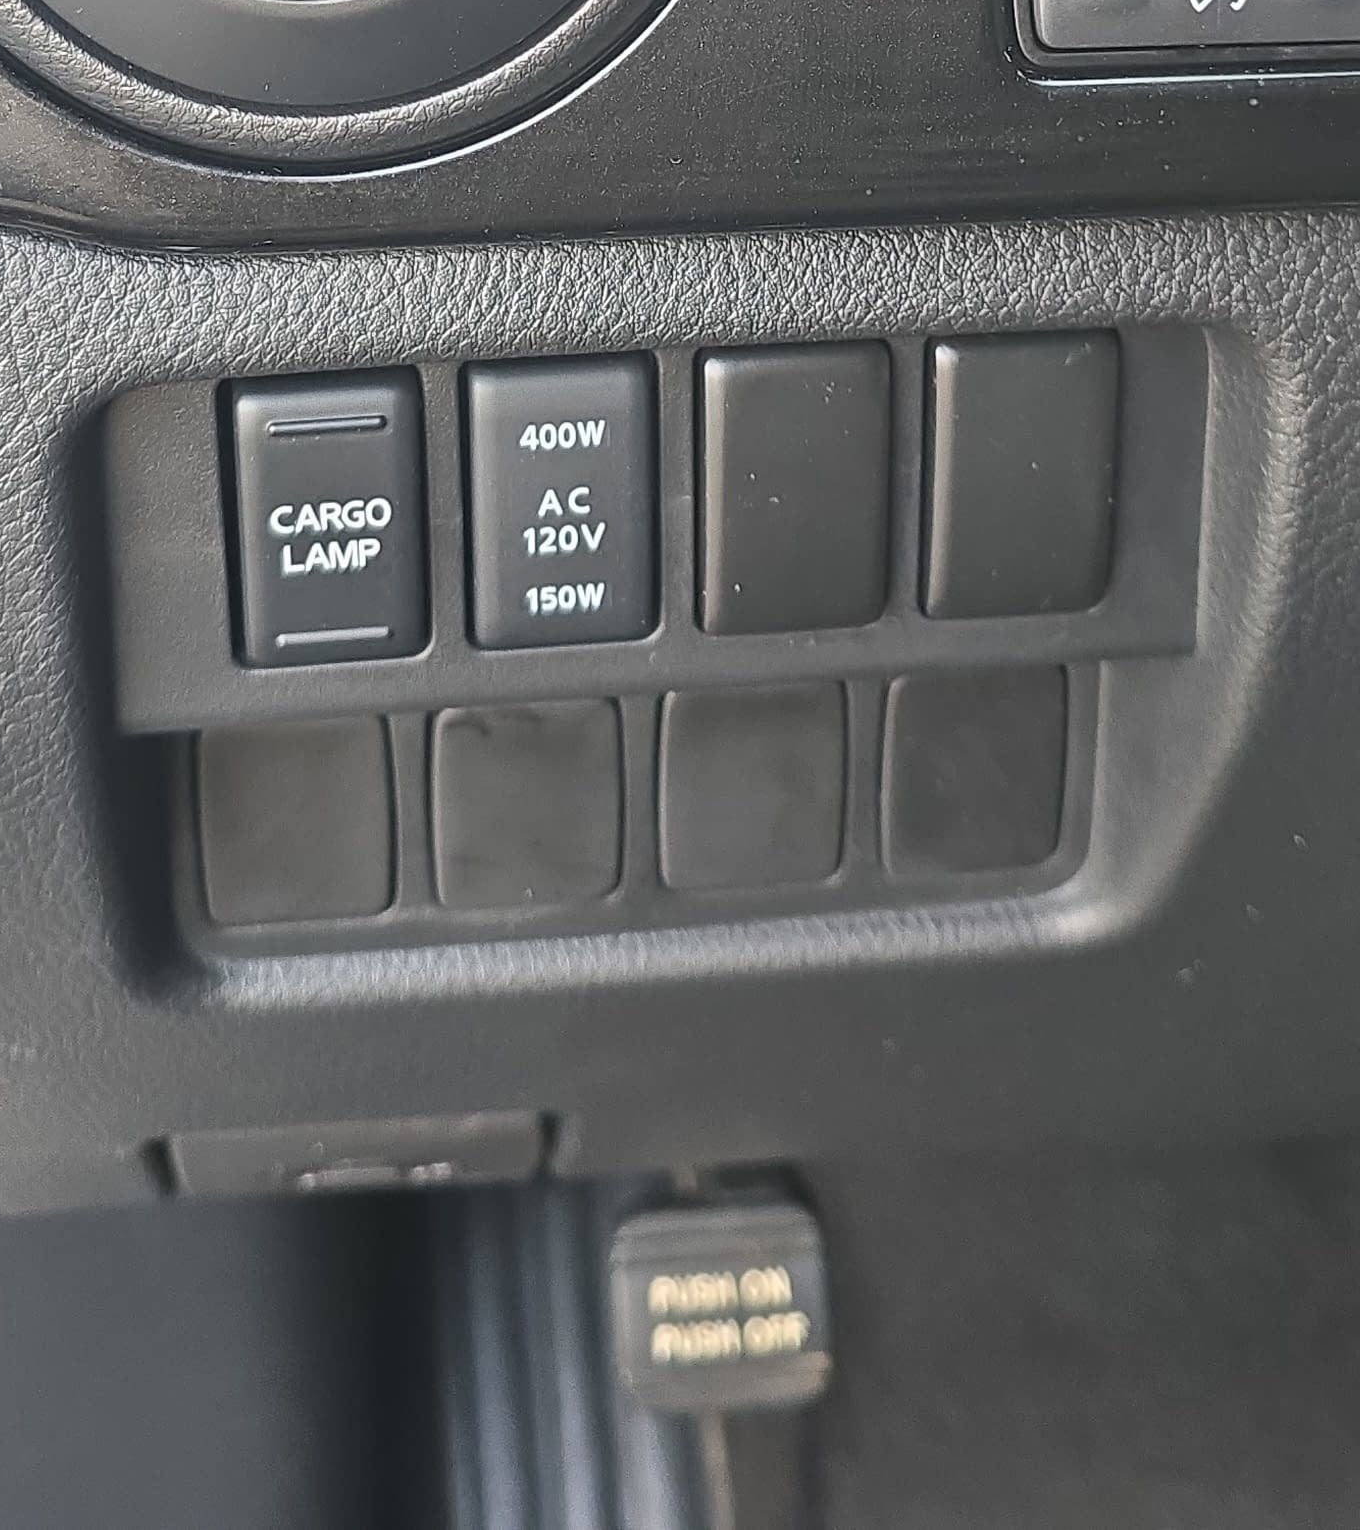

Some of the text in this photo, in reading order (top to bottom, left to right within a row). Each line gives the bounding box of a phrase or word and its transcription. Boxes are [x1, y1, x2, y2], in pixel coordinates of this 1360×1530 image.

[518, 419, 608, 452] 400W
[269, 497, 393, 536] CARGO
[280, 536, 382, 575] LAMP
[522, 521, 607, 555] 120V
[525, 582, 606, 615] 150W
[648, 1266, 793, 1314] PUSH ON
[651, 1311, 810, 1362] PUSH OFF
